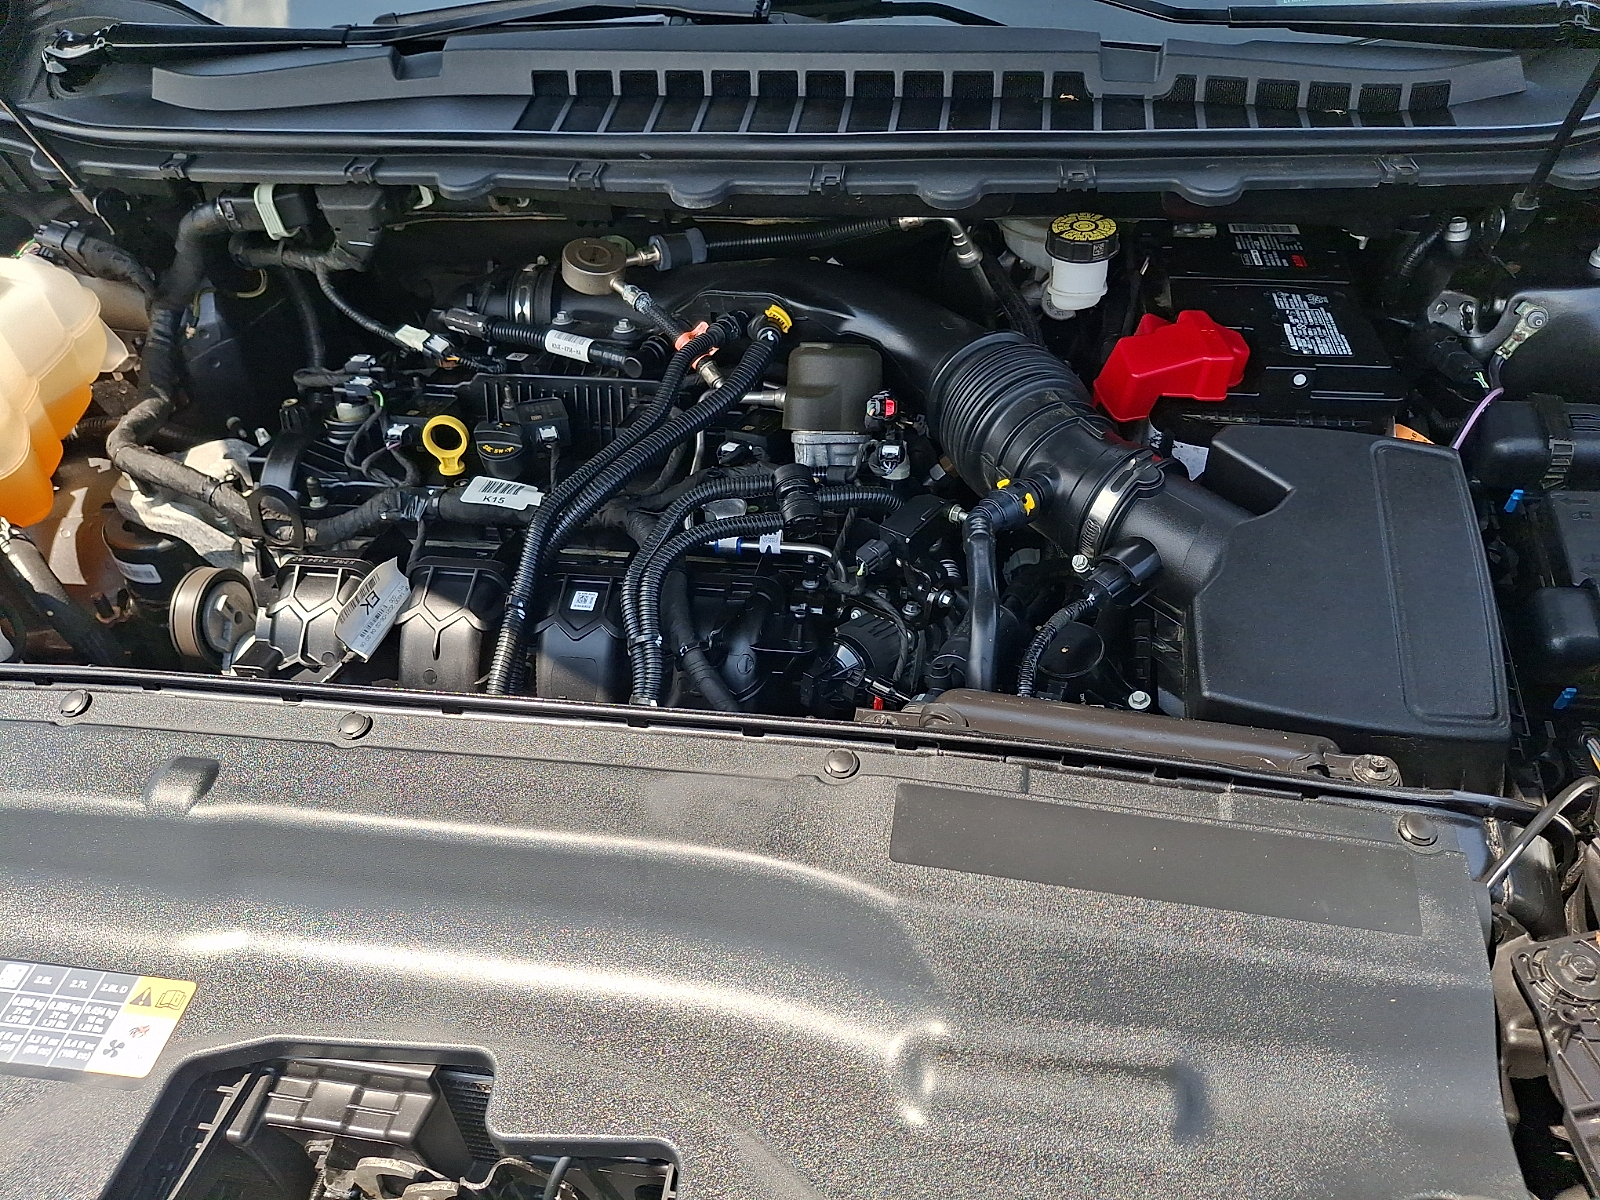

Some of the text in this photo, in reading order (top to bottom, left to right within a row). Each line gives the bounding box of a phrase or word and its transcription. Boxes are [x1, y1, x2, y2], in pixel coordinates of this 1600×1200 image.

[483, 495, 505, 504] K15
[360, 590, 381, 615] EK
[69, 979, 88, 989] 2.7L
[119, 985, 129, 994] D
